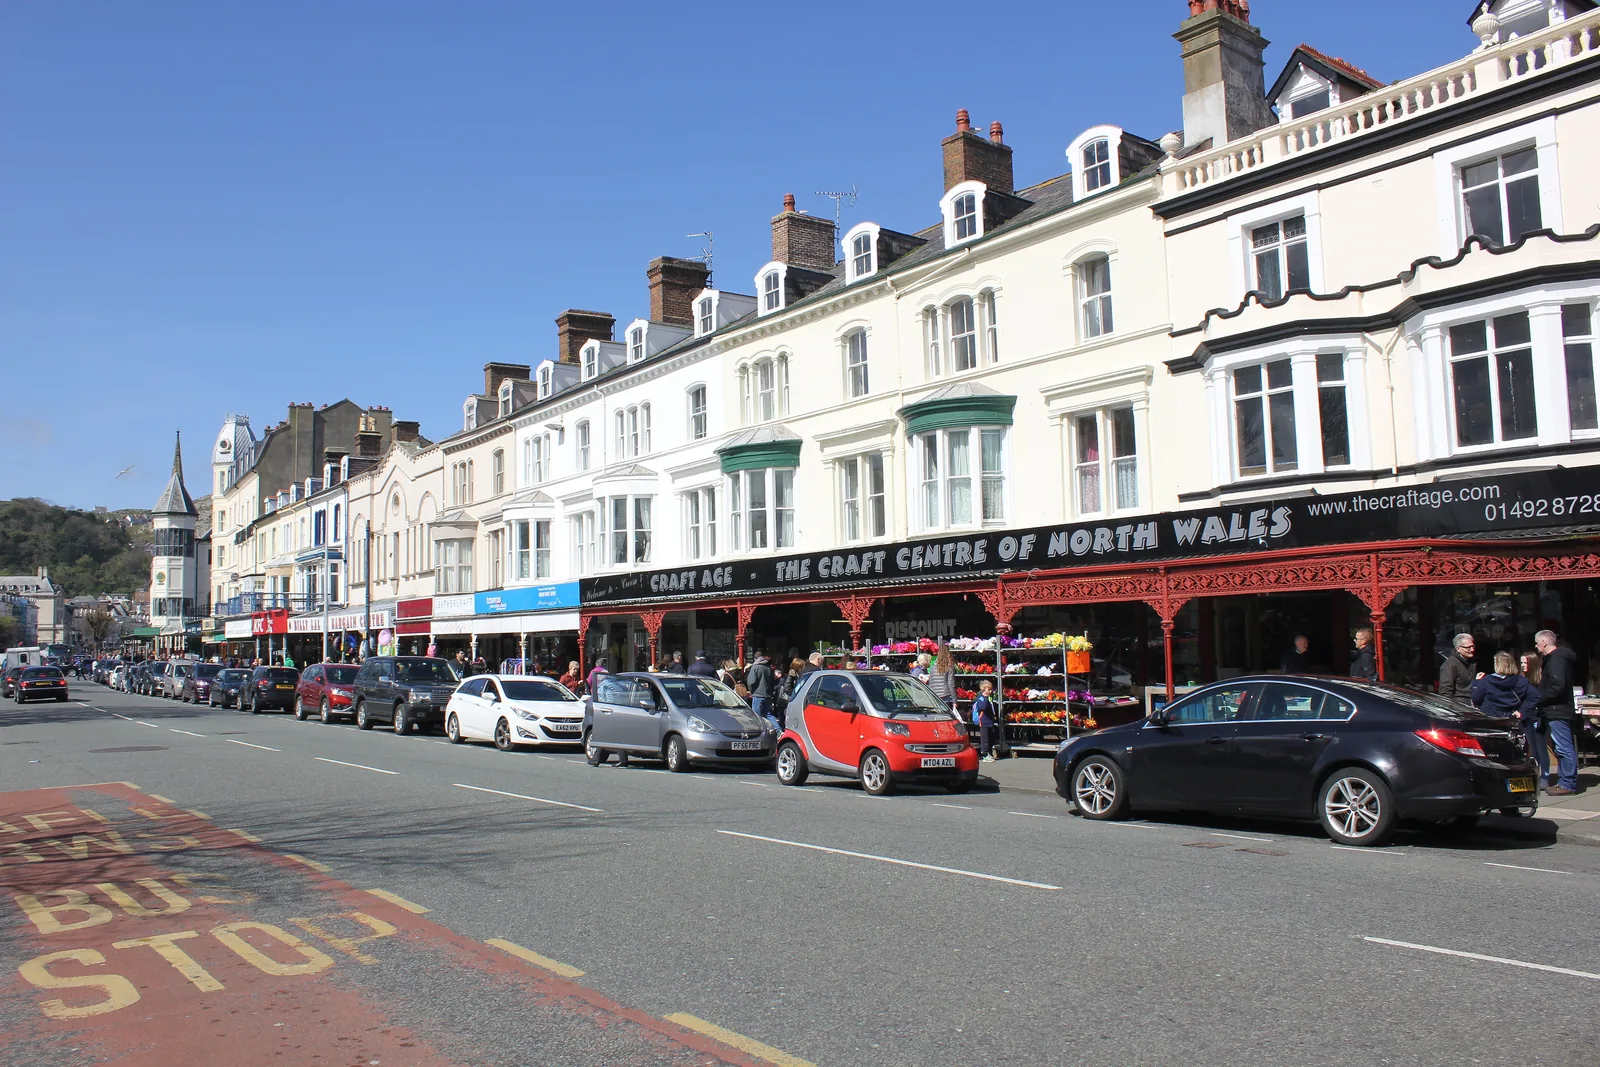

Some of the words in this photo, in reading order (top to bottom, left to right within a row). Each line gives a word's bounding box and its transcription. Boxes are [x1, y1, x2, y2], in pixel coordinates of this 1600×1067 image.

[1308, 485, 1500, 516] www.thecraftage.com
[1485, 499, 1548, 522] 01492
[650, 571, 697, 592] CRAFT
[702, 566, 733, 588] AGE
[776, 559, 811, 582] THE
[818, 551, 886, 577] CRAFT
[896, 539, 988, 570] CENTRE
[998, 533, 1037, 562] OF
[1047, 521, 1159, 558] NORTH
[1172, 506, 1293, 546] WALES
[253, 618, 264, 633] KFC
[331, 615, 357, 630] BARGAIN
[359, 612, 385, 627] CETRE
[885, 619, 956, 638] DISCOUNT
[941, 758, 953, 766] AZL
[14, 872, 256, 934] BUS
[18, 911, 398, 1020] STOP
